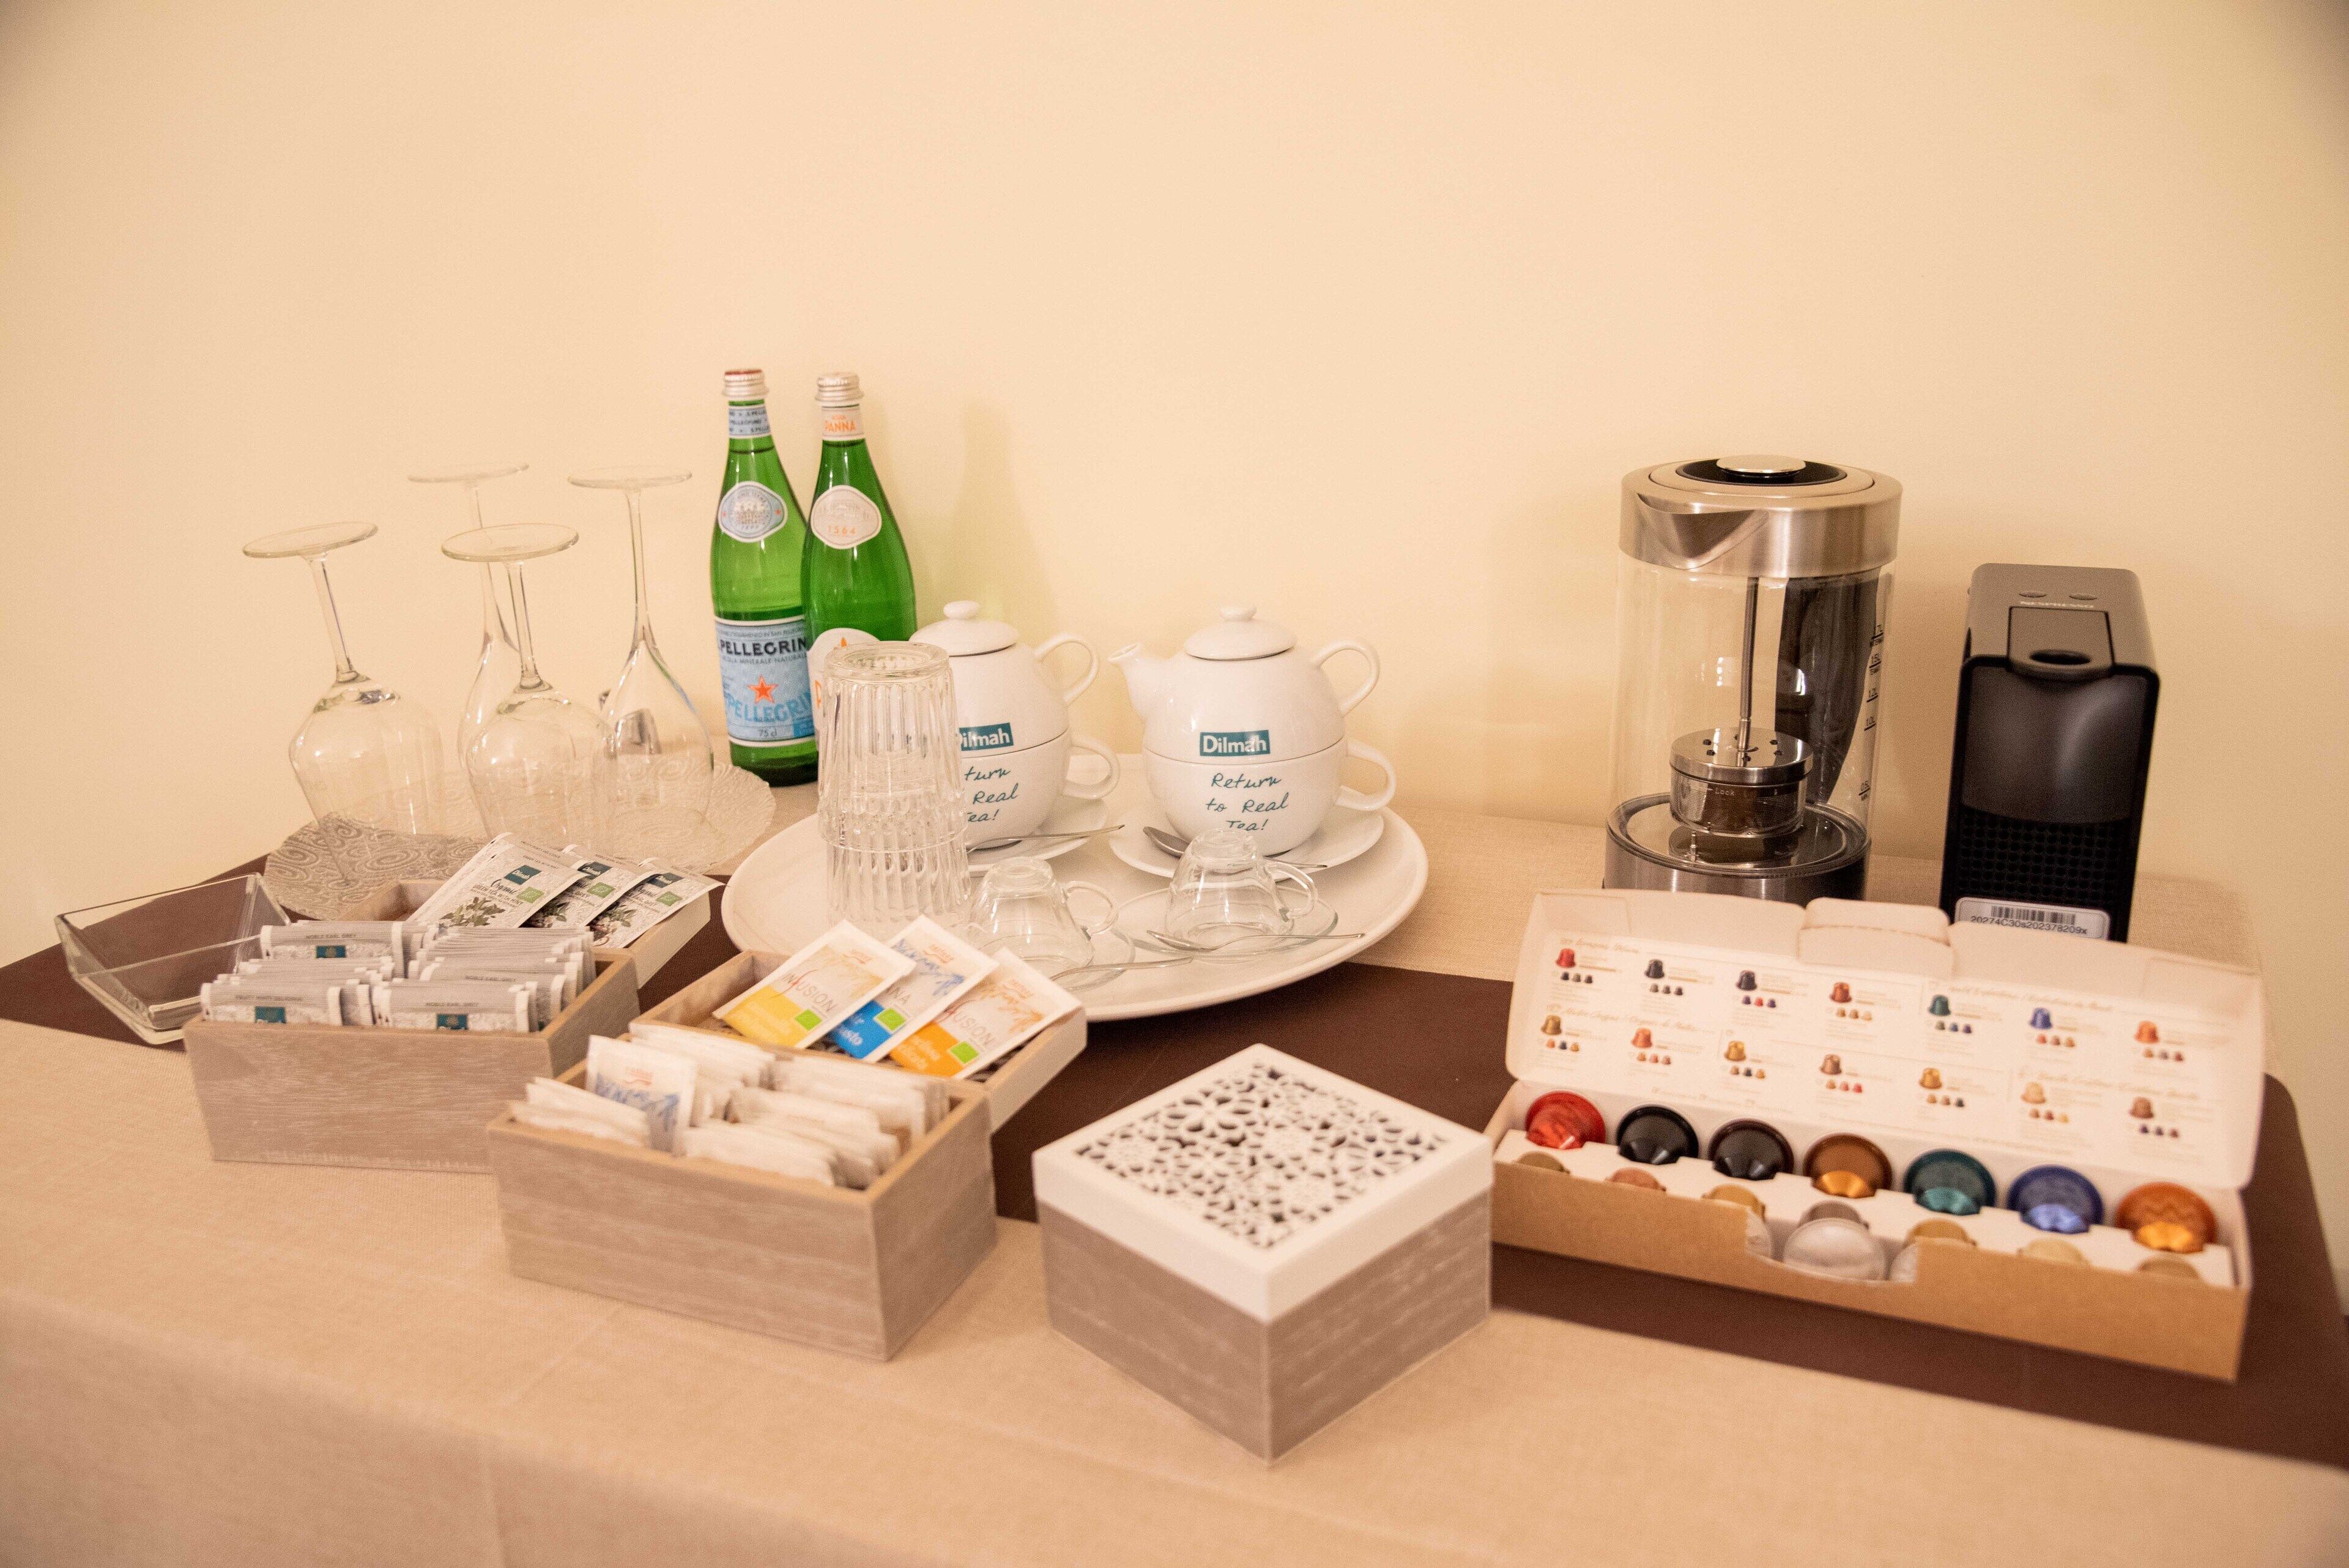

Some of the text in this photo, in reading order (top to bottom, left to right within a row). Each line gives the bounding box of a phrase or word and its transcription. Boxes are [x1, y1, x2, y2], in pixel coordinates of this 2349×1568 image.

[960, 727, 1010, 748] ilmah
[1203, 734, 1267, 754] Dilmah
[964, 765, 1011, 781] turn
[1211, 772, 1282, 789] Return
[972, 782, 1019, 804] Real
[1715, 787, 1735, 796] Lock
[1205, 792, 1290, 813] to Real
[1226, 819, 1269, 831] Tea!
